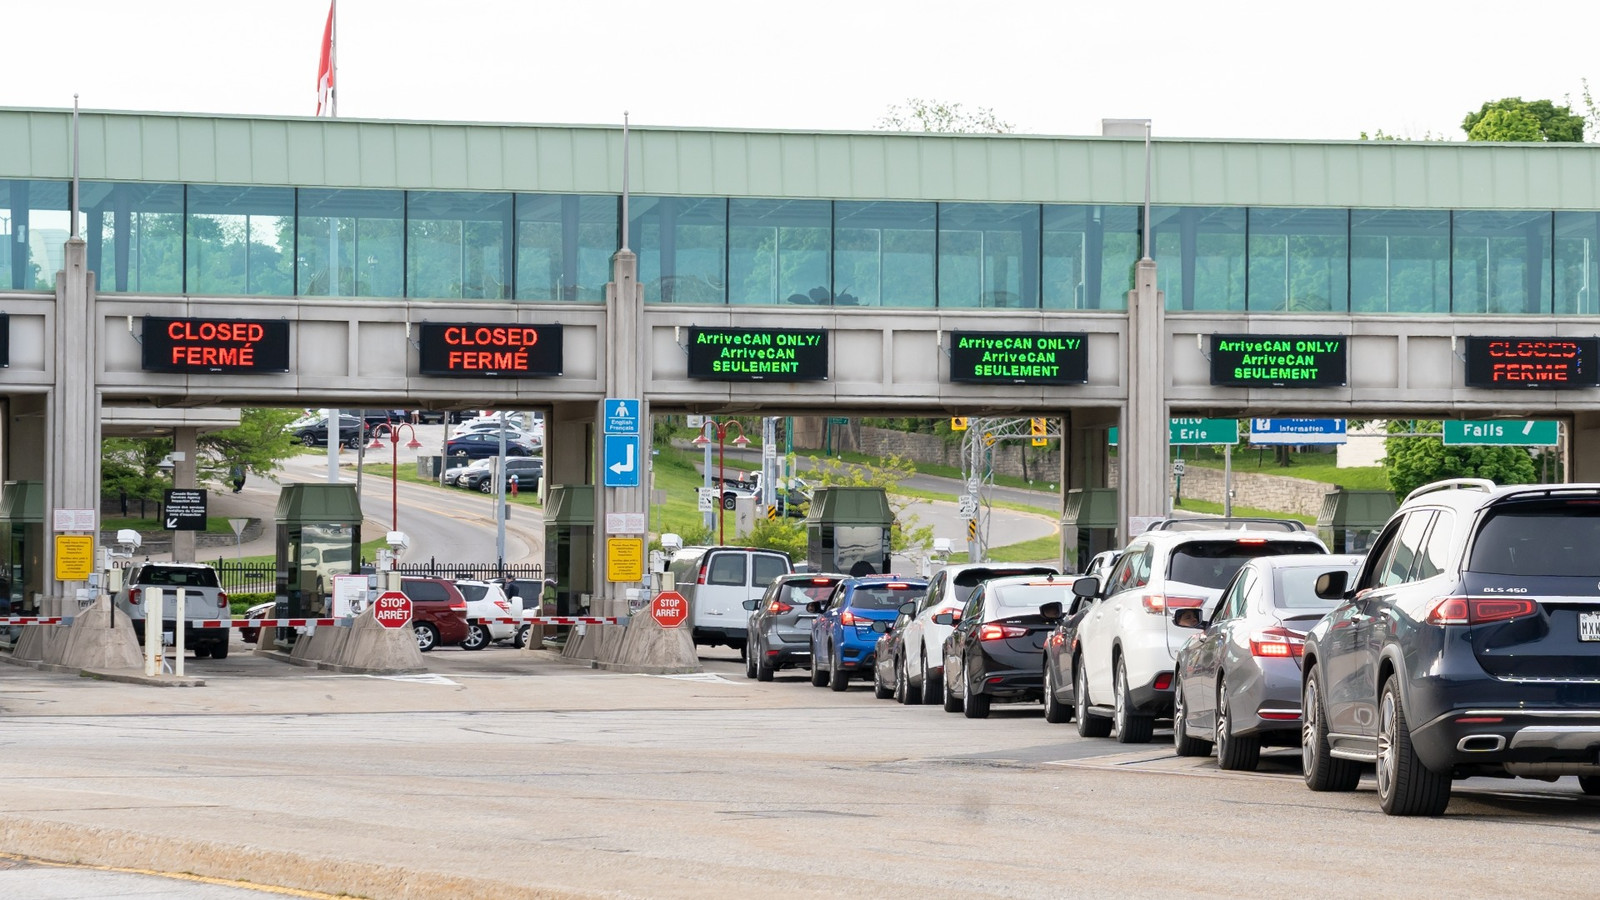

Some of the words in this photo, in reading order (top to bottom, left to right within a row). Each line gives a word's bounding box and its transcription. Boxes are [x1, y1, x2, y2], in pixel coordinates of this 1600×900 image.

[168, 322, 264, 341] CLOSED
[444, 328, 538, 345] CLOSED
[697, 333, 771, 345] ArriveCAN
[776, 335, 820, 346] ONLY/
[959, 338, 1032, 349] ArriveCAN
[1037, 339, 1080, 350] ONLY/
[1219, 341, 1290, 352] ArriveCAN
[1296, 342, 1338, 352] ONLY/
[1489, 342, 1576, 357] CLOSED
[172, 343, 254, 365] FERMÉ
[449, 347, 528, 370] FERMÉ
[721, 347, 795, 359] ArriveCAN
[982, 352, 1055, 362] ArriveCAN
[1242, 354, 1314, 365] ArriveCAN
[713, 361, 799, 373] SEULEMENT
[975, 365, 1059, 376] SEULEMENT
[1234, 368, 1318, 379] SEULEMENT
[1180, 429, 1207, 439] Erie
[1464, 424, 1503, 436] Falls
[381, 598, 406, 607] STOP
[378, 608, 409, 619] ARRÊT
[656, 607, 680, 617] ARRÊT
